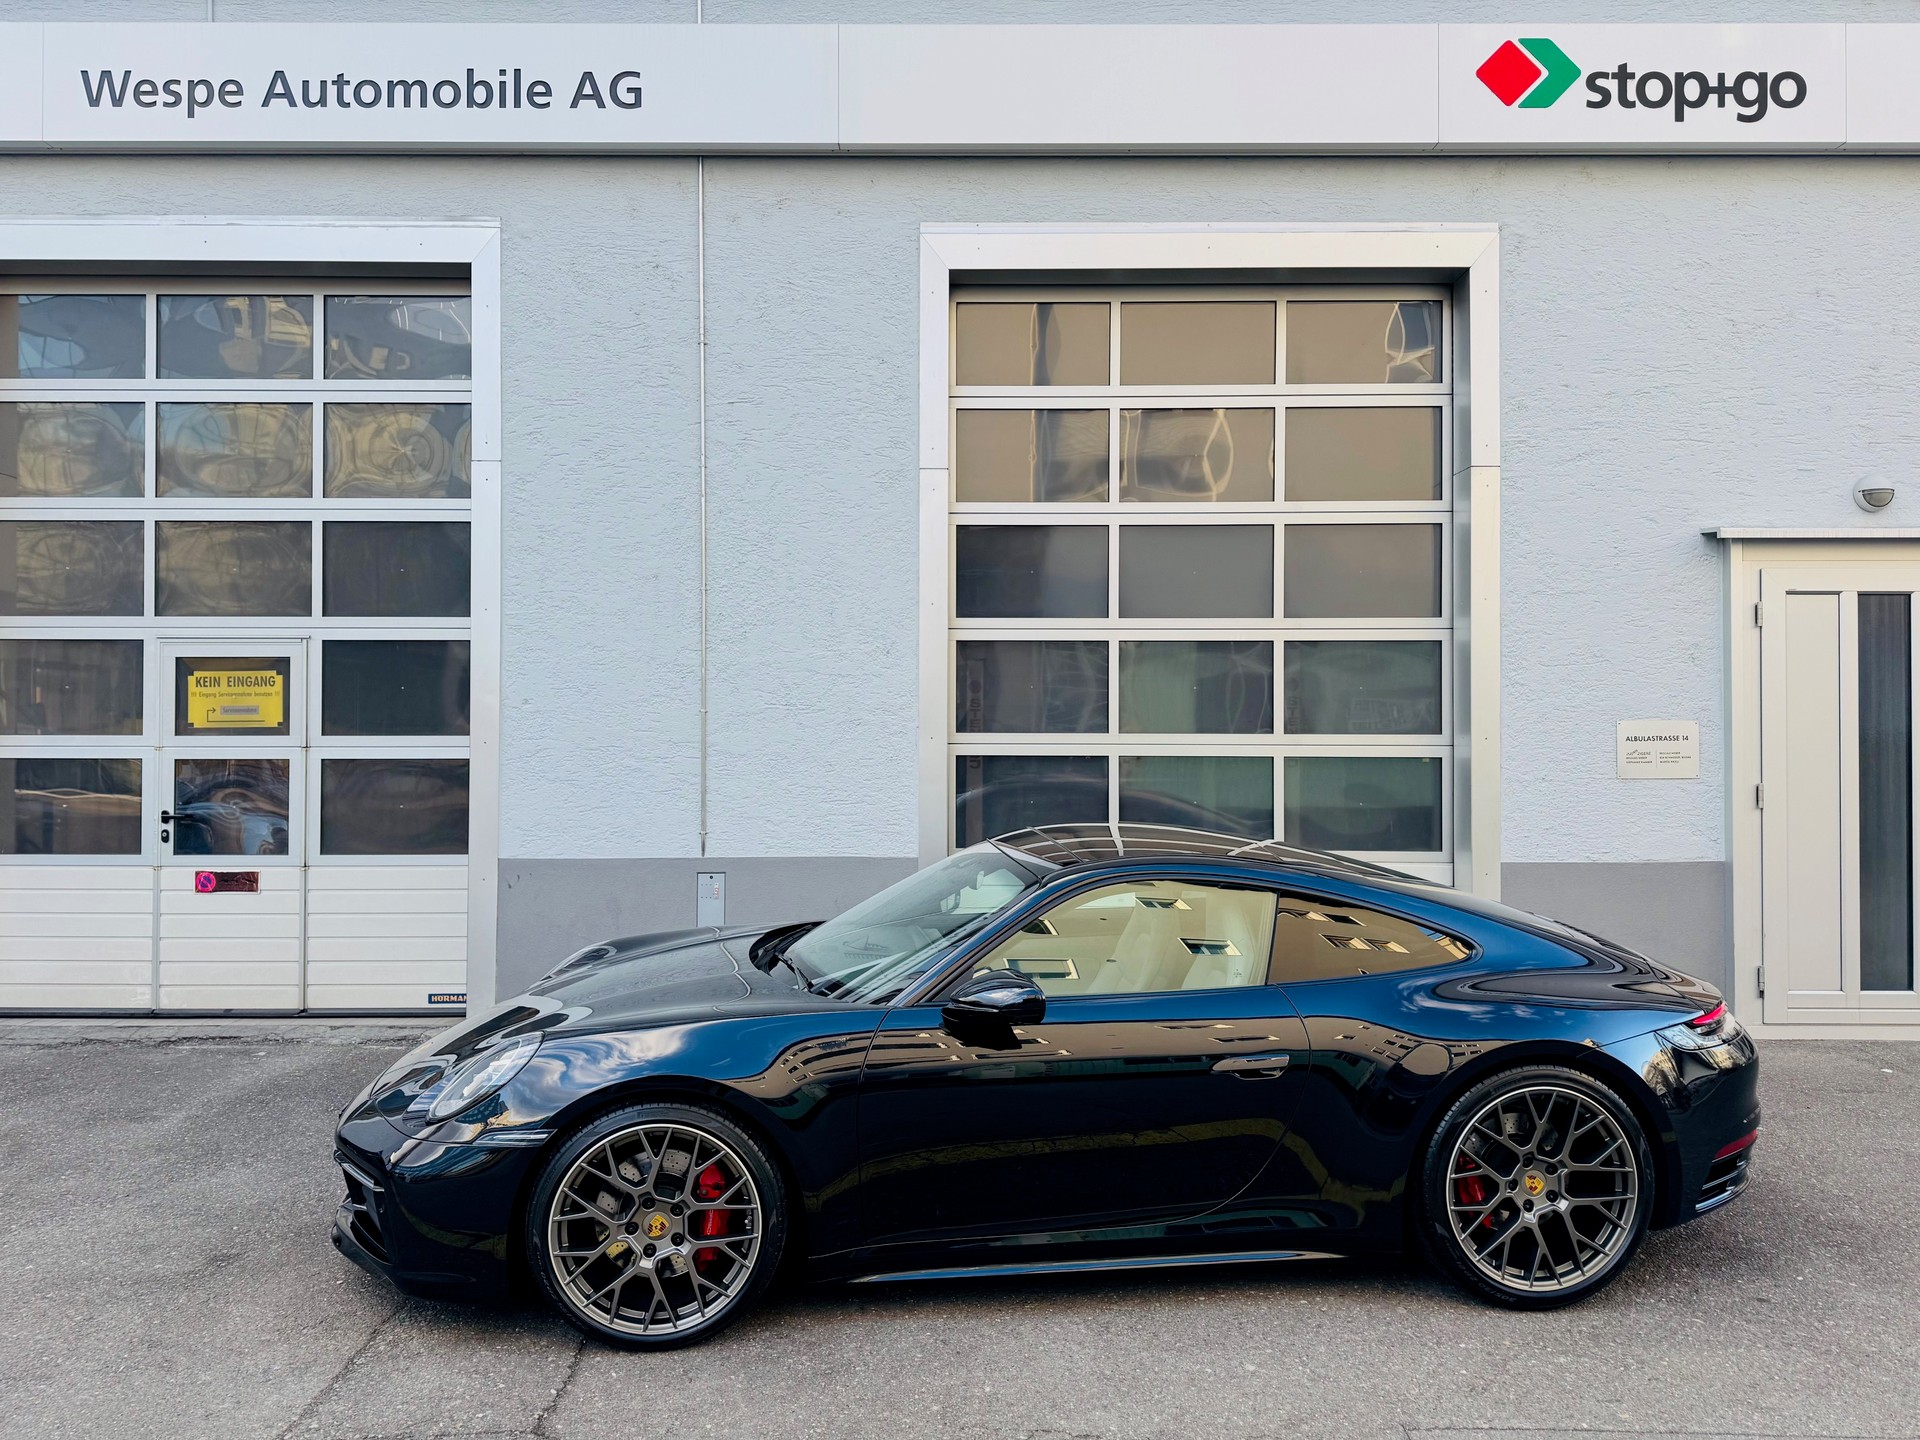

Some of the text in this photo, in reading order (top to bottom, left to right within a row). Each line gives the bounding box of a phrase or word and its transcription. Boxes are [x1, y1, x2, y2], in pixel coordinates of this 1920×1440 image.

[81, 67, 643, 118] Wespe Automobile AG
[1585, 62, 1808, 124] stop+go
[195, 676, 276, 688] KEIN EINGANG
